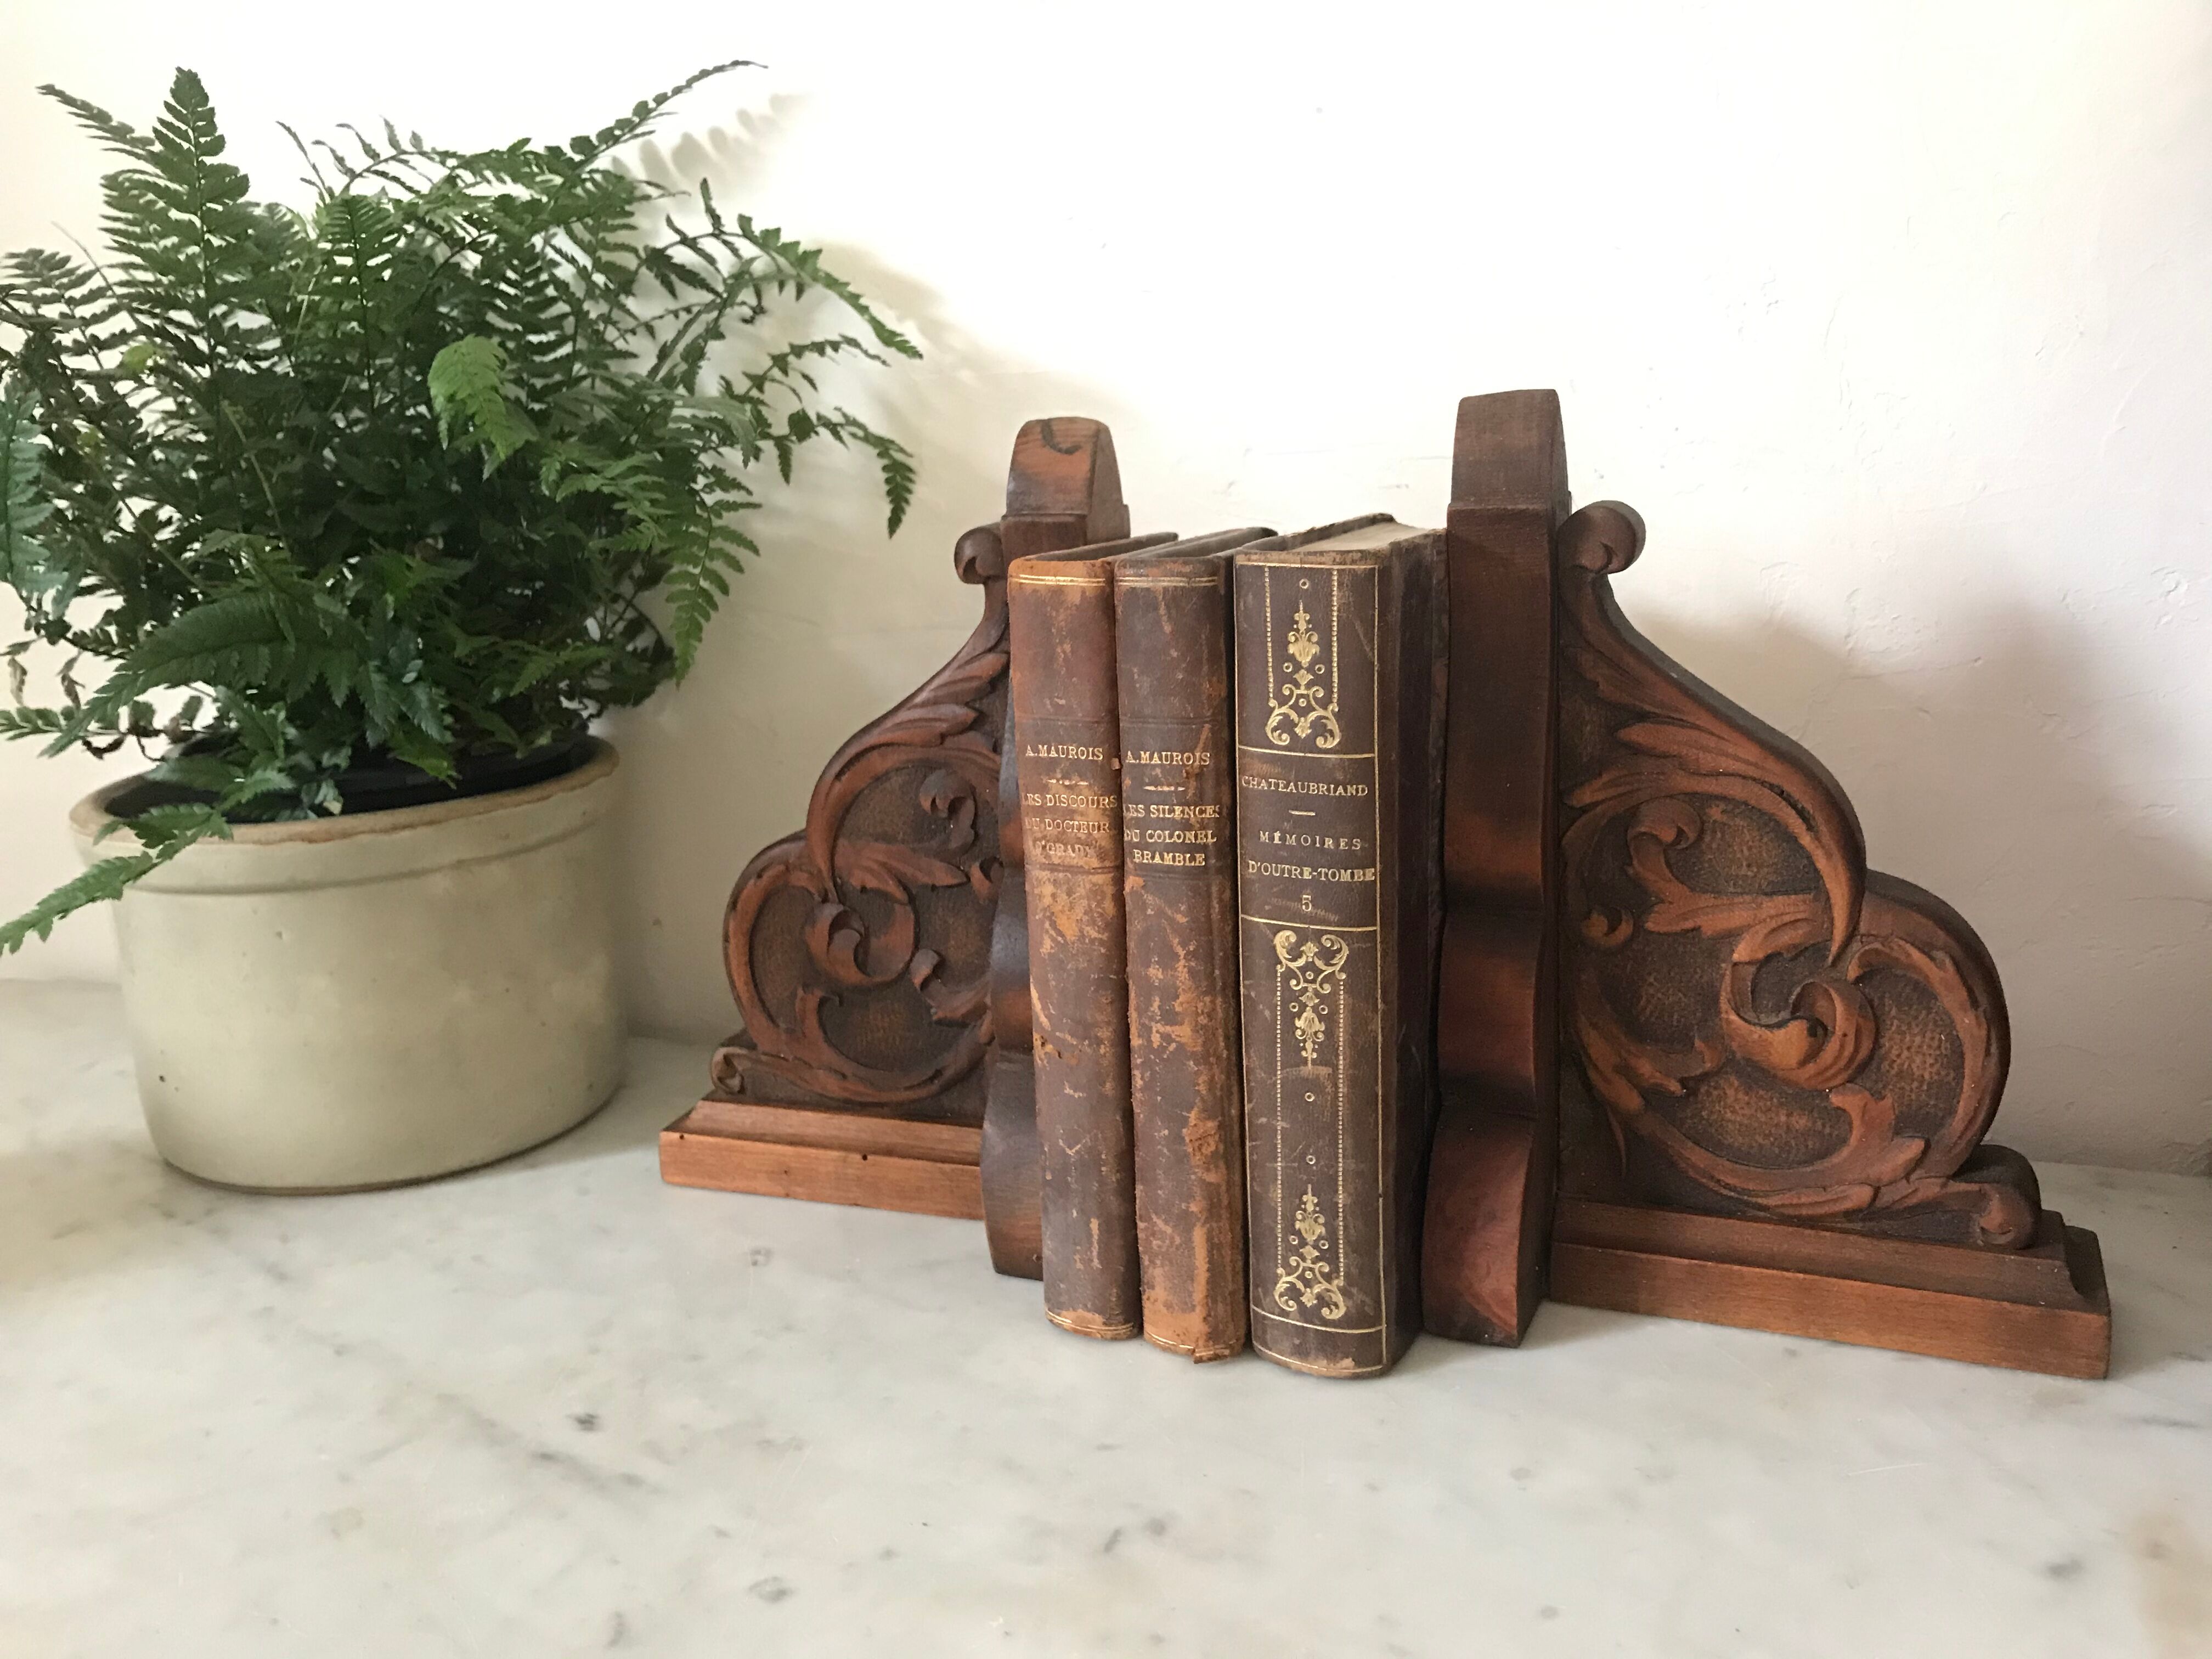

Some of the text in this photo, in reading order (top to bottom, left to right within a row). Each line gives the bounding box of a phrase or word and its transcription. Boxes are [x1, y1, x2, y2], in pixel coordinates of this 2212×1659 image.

[1025, 744, 1103, 760] A.MAUROIS
[1126, 751, 1210, 766] A.MAUROIS
[1242, 776, 1368, 797] CHATEAUBRIAND
[1046, 794, 1118, 808] DISCOURS
[1045, 819, 1110, 833] DOCTEUR
[1124, 828, 1217, 844] DU COLONEL
[1259, 831, 1362, 850] MÉMOIRES
[1133, 849, 1205, 866] BRAMBLE
[1248, 860, 1375, 882] D'OUTRE-TOMBE
[1301, 895, 1312, 912] 5
